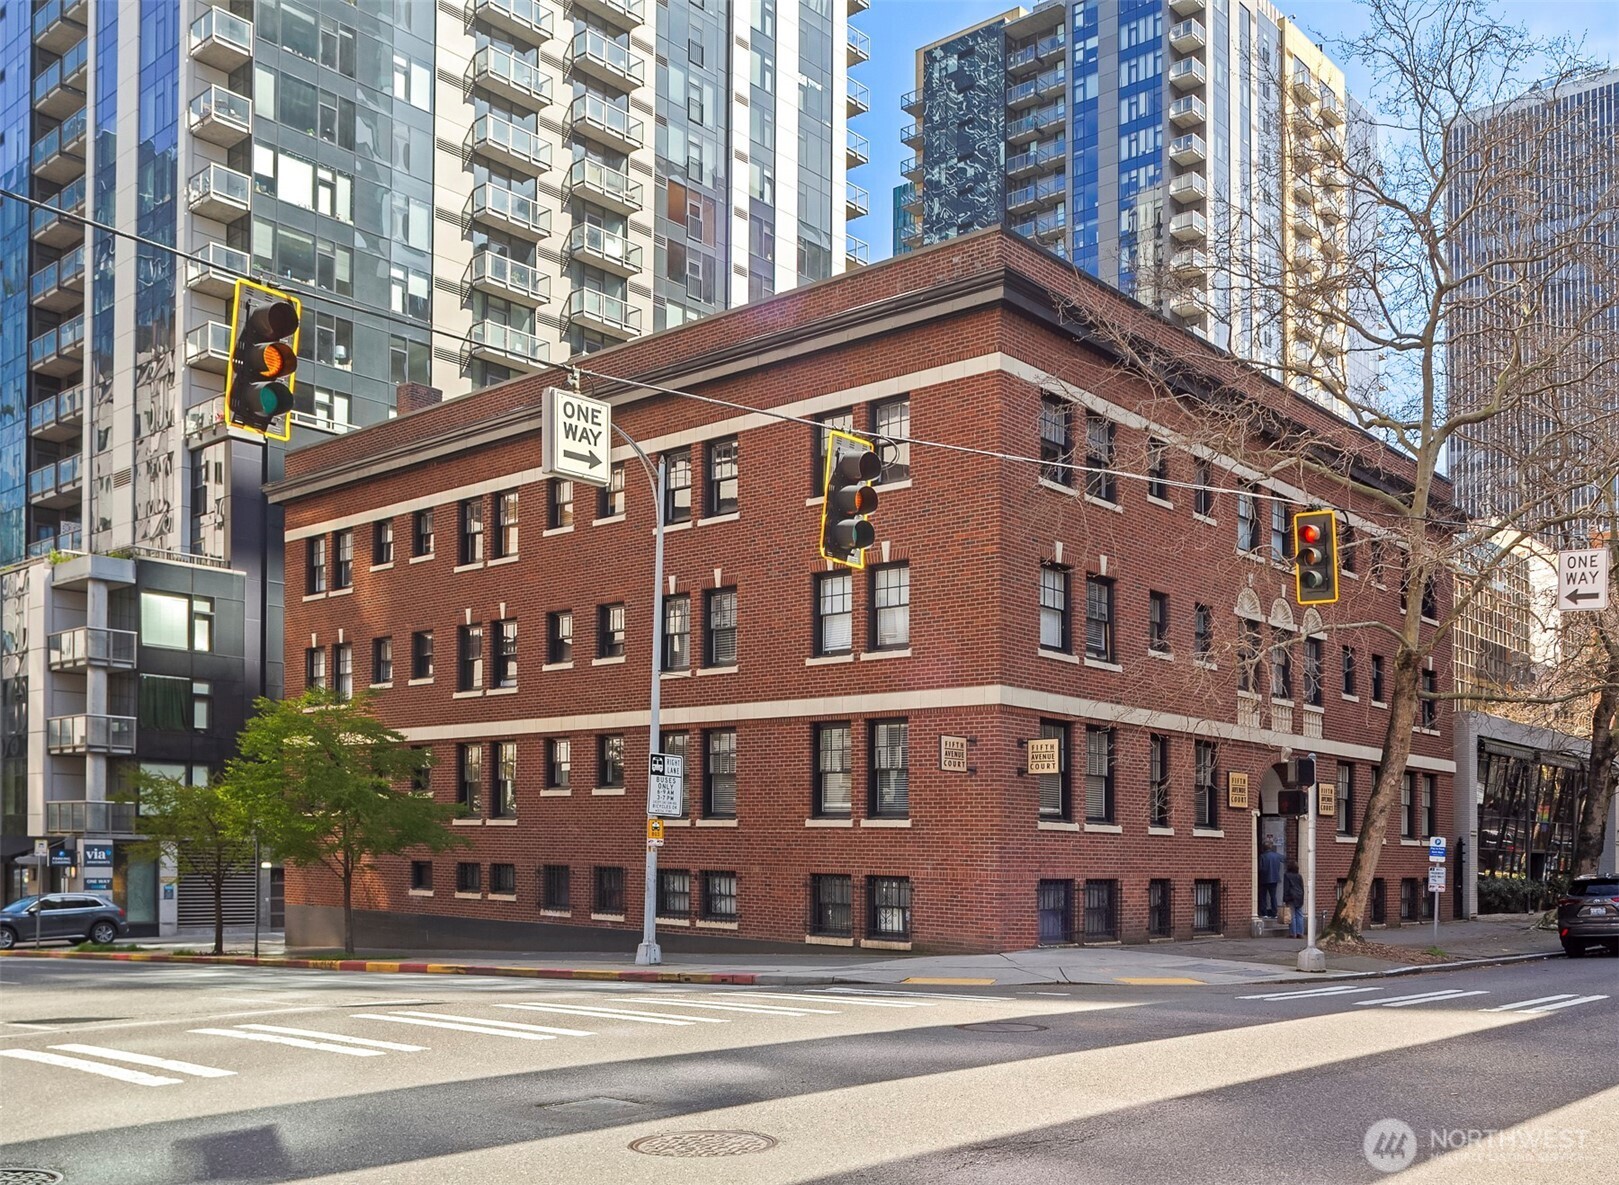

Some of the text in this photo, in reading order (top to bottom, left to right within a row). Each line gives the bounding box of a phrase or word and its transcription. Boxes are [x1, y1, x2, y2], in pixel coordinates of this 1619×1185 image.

[563, 401, 602, 427] ONE
[563, 421, 602, 447] WAY
[1567, 555, 1598, 569] ONE
[1566, 571, 1599, 585] WAY
[945, 741, 964, 749] FIFTH
[945, 750, 965, 758] AVENUE
[666, 758, 680, 766] RIGHT
[943, 760, 965, 768] COURT
[667, 767, 680, 775] LANE
[656, 776, 677, 784] BUSES
[1231, 777, 1246, 785] FIFTH
[86, 848, 106, 859] via
